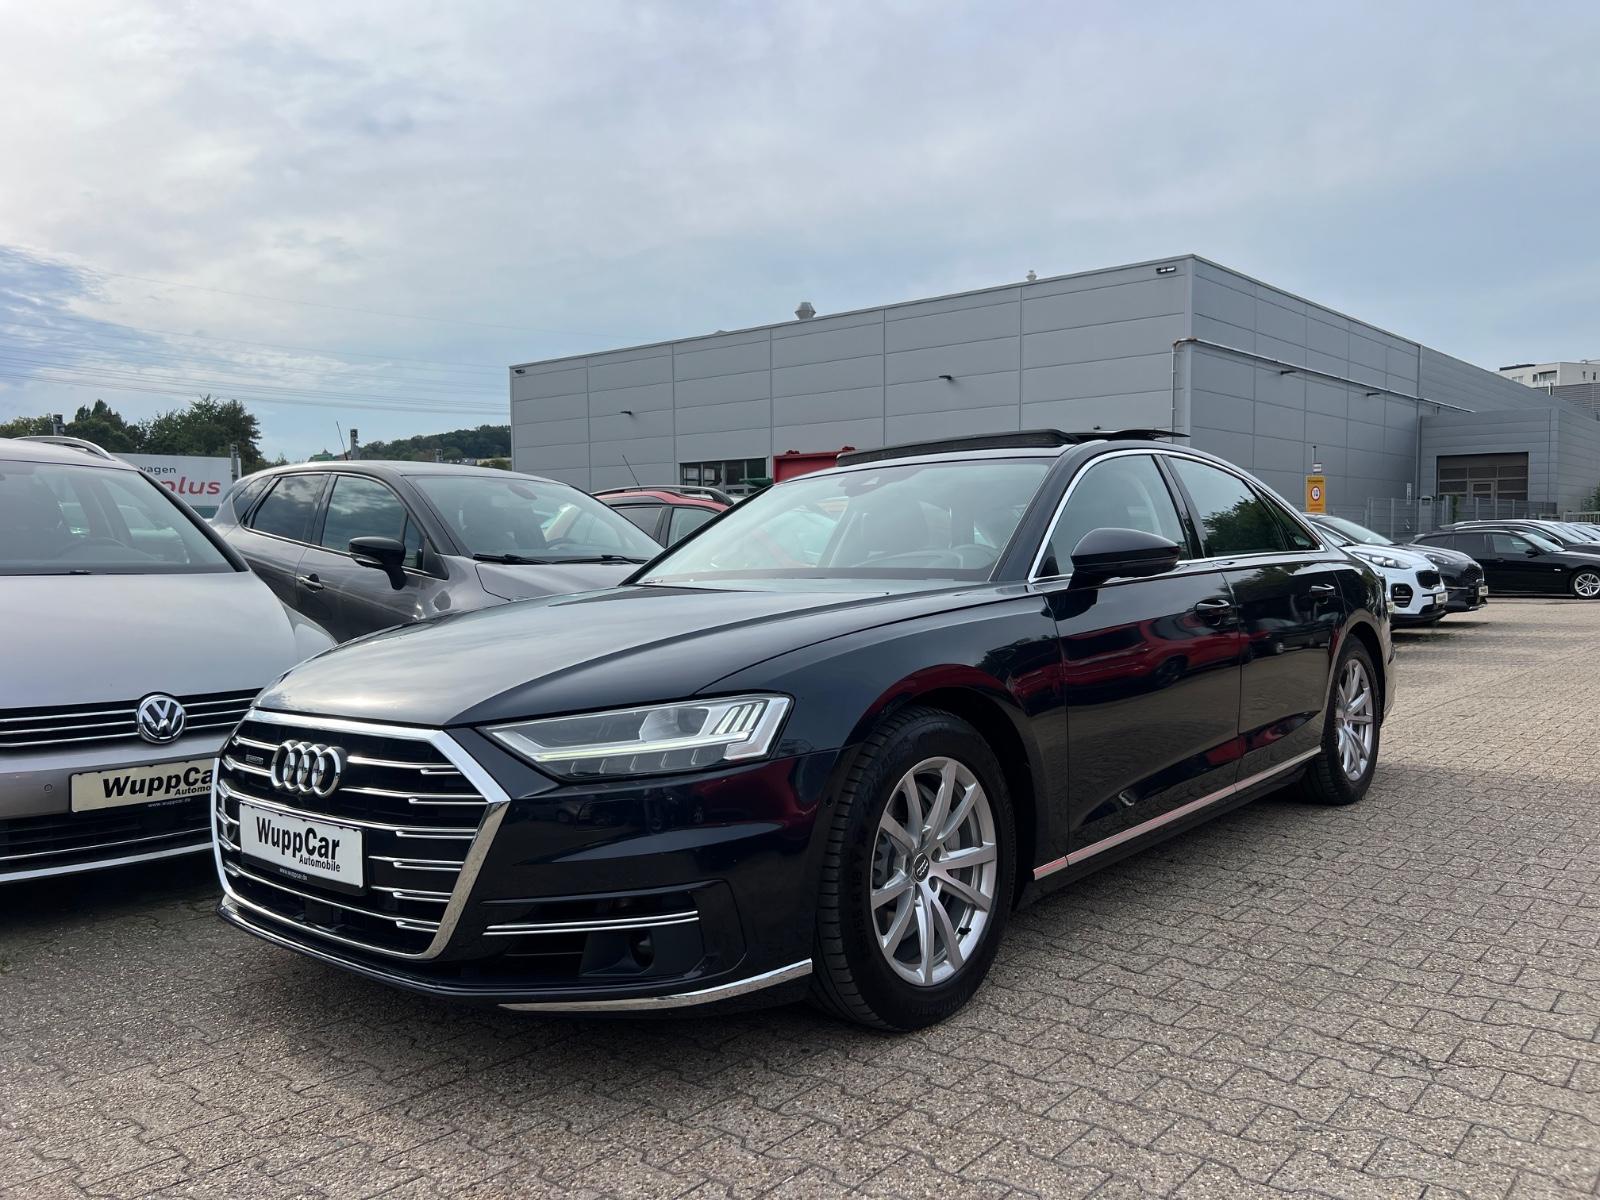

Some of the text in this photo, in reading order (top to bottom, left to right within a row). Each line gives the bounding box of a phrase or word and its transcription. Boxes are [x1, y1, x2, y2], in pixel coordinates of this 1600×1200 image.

[102, 766, 214, 798] WuppCa
[256, 816, 340, 861] WuppCar
[298, 853, 341, 873] Automobile
